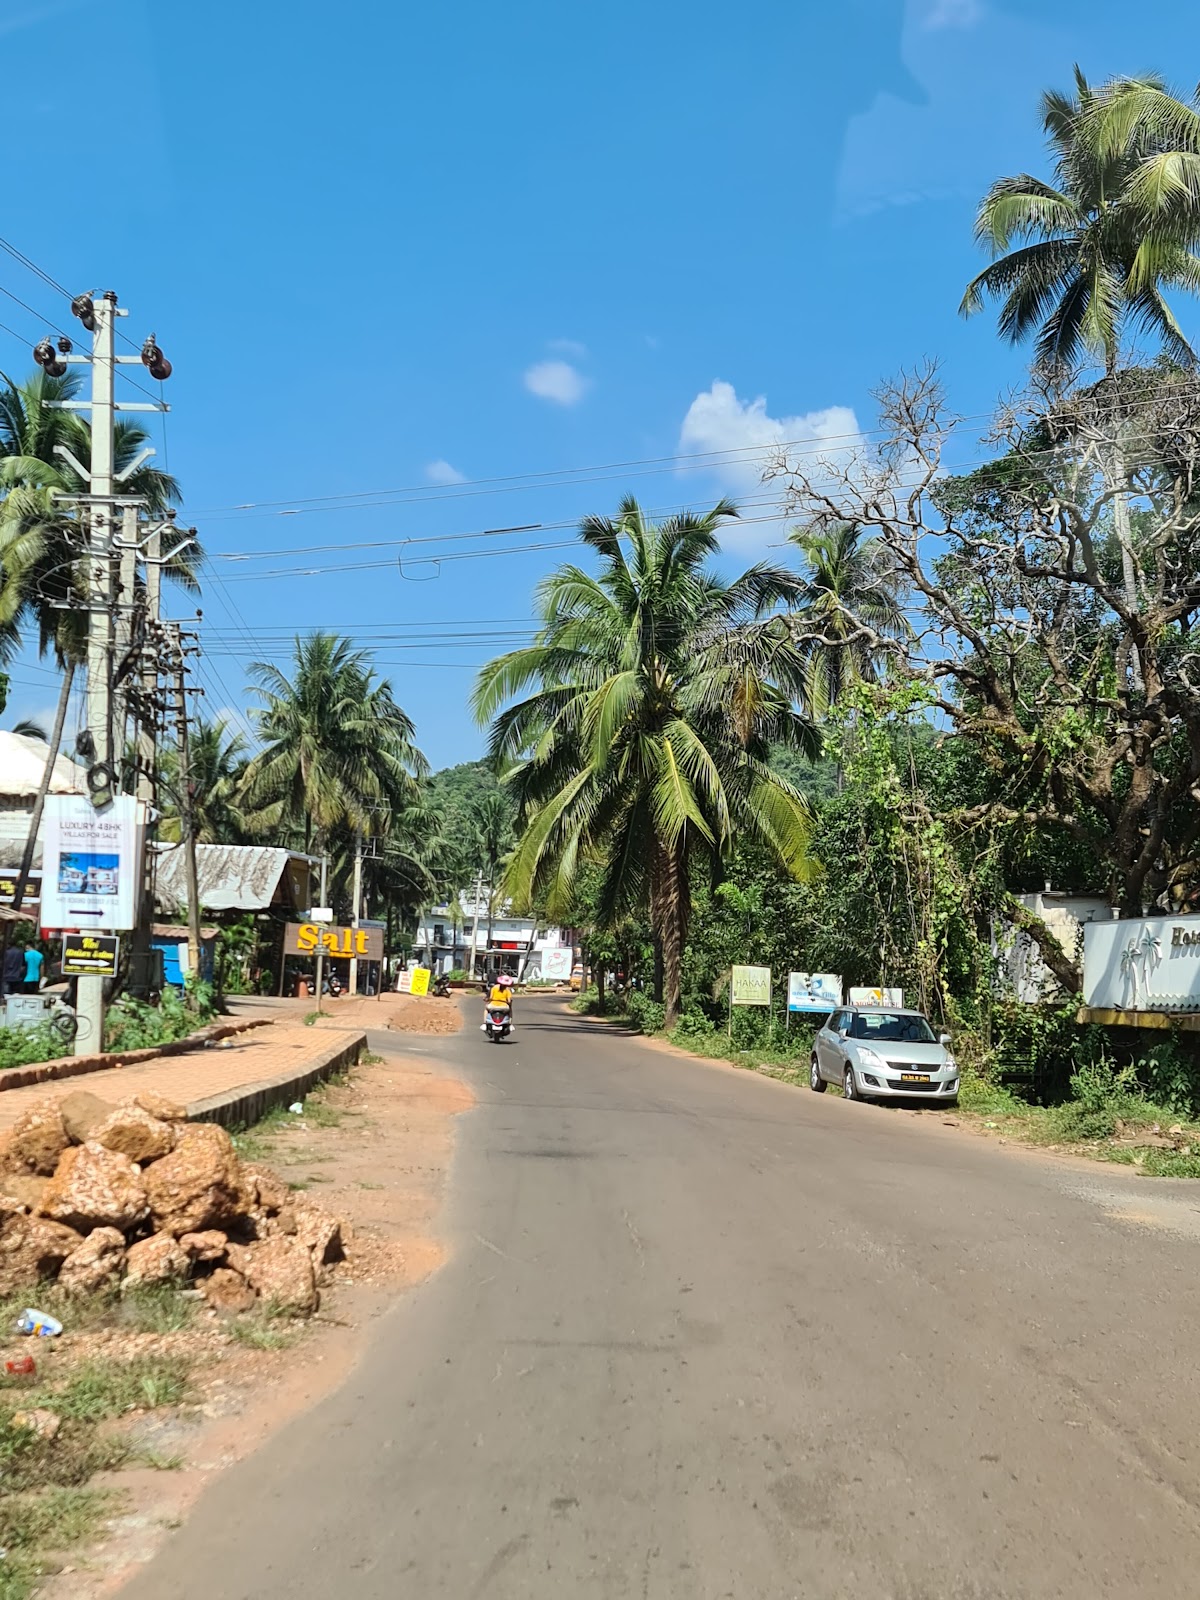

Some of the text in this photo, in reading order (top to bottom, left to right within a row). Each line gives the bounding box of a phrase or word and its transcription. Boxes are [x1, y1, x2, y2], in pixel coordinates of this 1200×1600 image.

[60, 821, 94, 830] LUXURY
[297, 924, 369, 954] Salt
[737, 979, 767, 988] HAKAA
